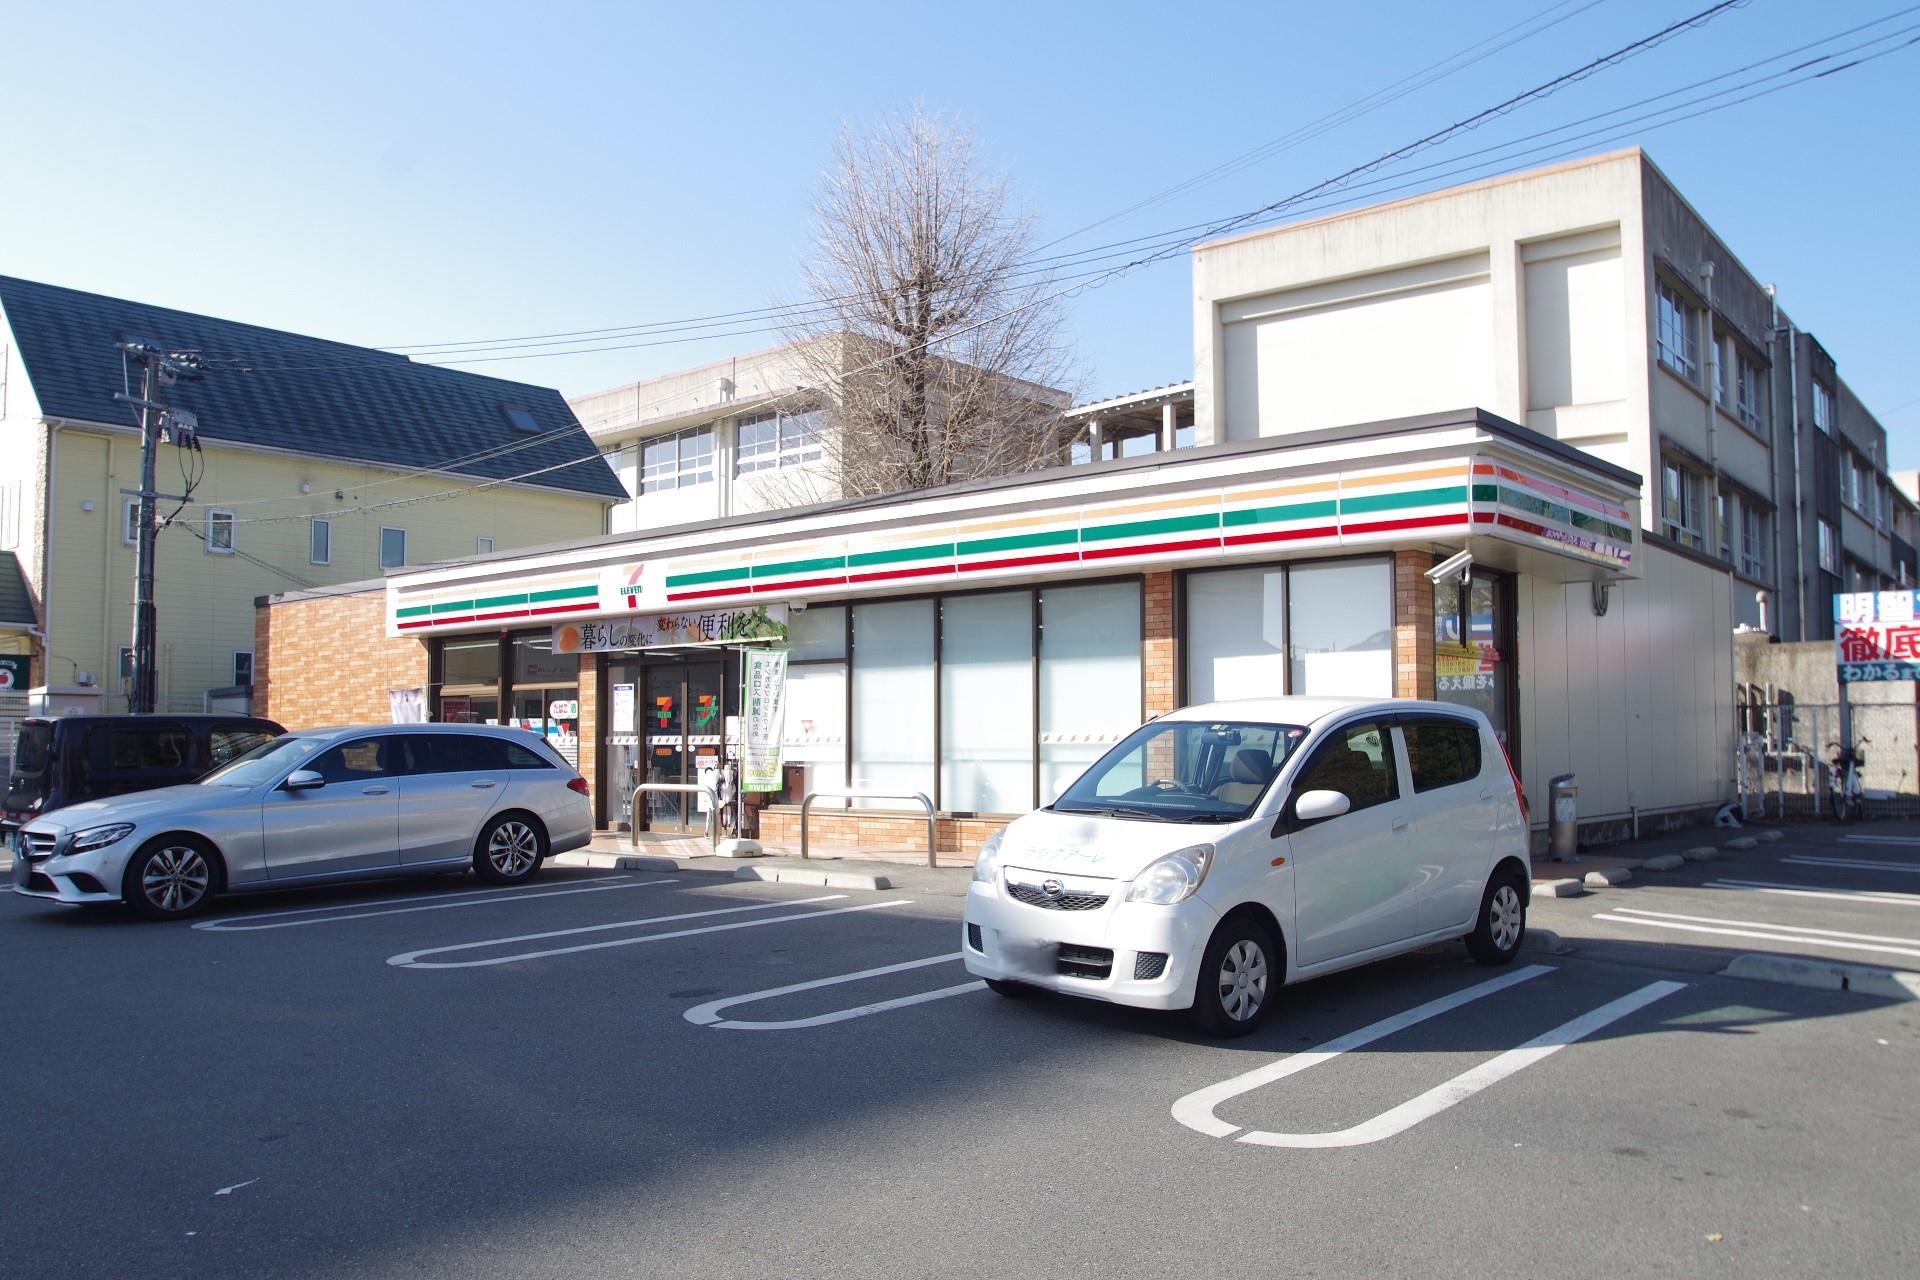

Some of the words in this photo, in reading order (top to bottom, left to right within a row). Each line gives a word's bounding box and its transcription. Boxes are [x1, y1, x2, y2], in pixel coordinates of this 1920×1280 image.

[580, 623, 653, 650] 暮らしの変化に
[656, 611, 752, 642] 変わらない便利を
[1840, 625, 1920, 663] 徹底
